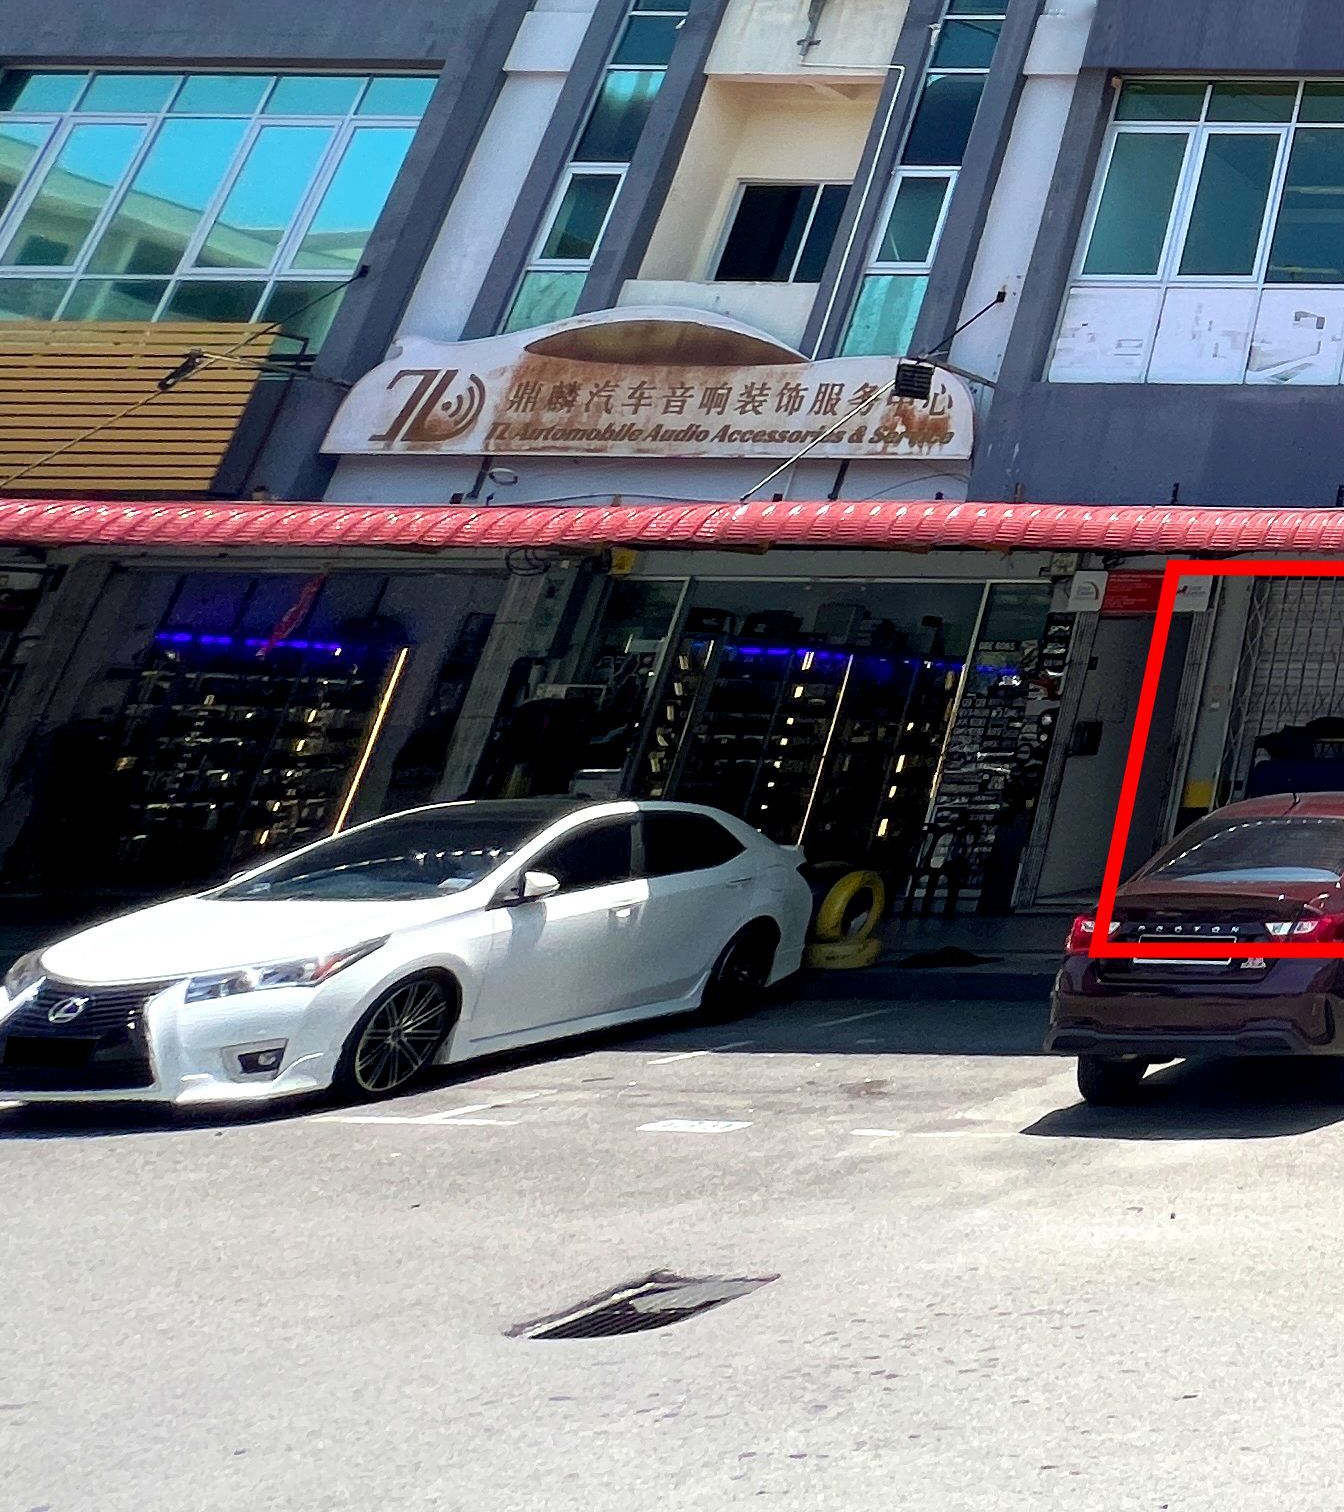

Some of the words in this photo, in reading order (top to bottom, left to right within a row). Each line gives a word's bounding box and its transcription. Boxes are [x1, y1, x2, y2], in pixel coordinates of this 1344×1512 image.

[512, 422, 642, 442] Automobile
[644, 423, 709, 442] Audio
[710, 424, 846, 443] Accessories
[848, 425, 867, 443] &
[1137, 924, 1240, 934] PROTON
